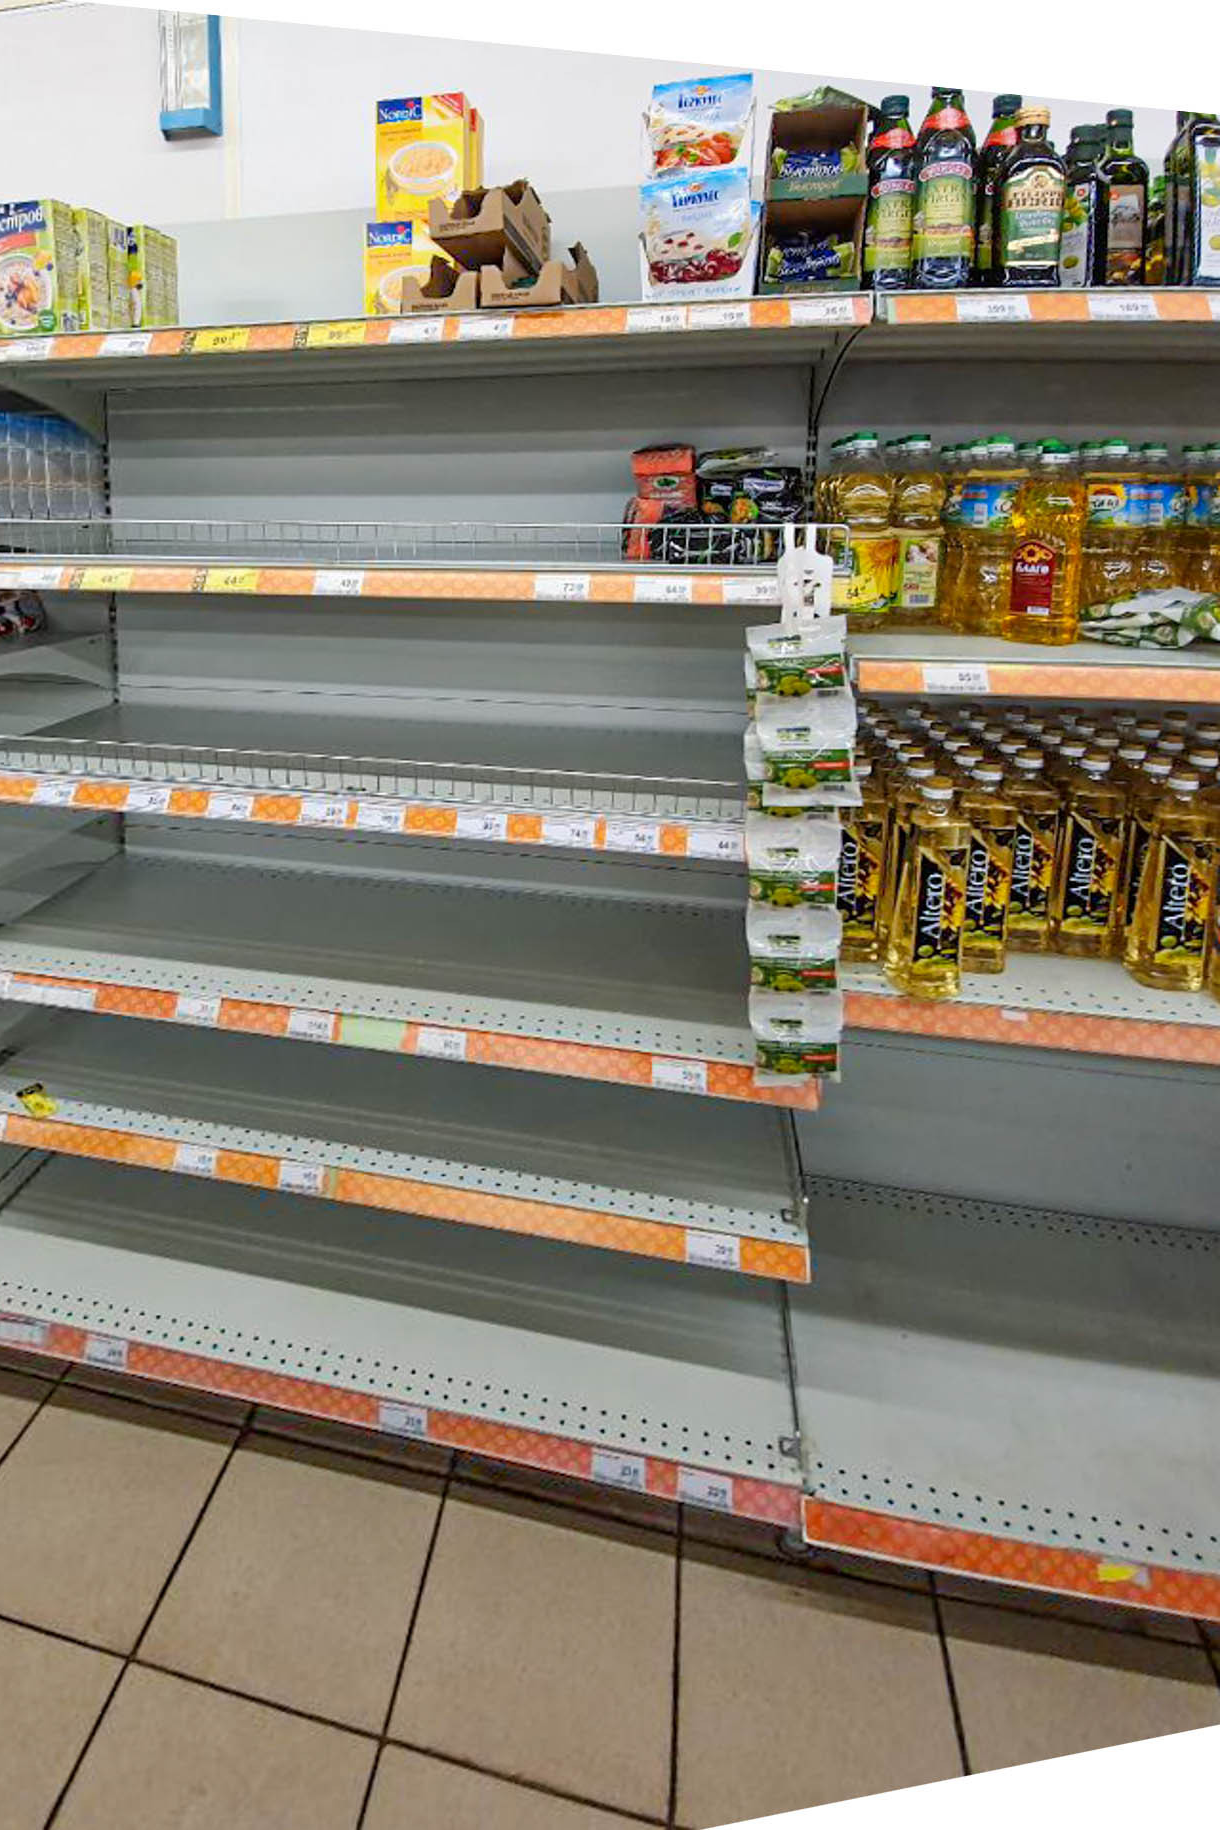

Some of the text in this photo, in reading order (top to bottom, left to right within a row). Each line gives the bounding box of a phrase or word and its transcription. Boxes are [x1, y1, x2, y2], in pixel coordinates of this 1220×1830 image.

[837, 841, 858, 905] Altero
[966, 849, 989, 915] Altero
[1011, 833, 1034, 897] Altero
[1069, 837, 1095, 901] Altero
[1162, 863, 1189, 930] Altero
[919, 872, 944, 939] Altero
